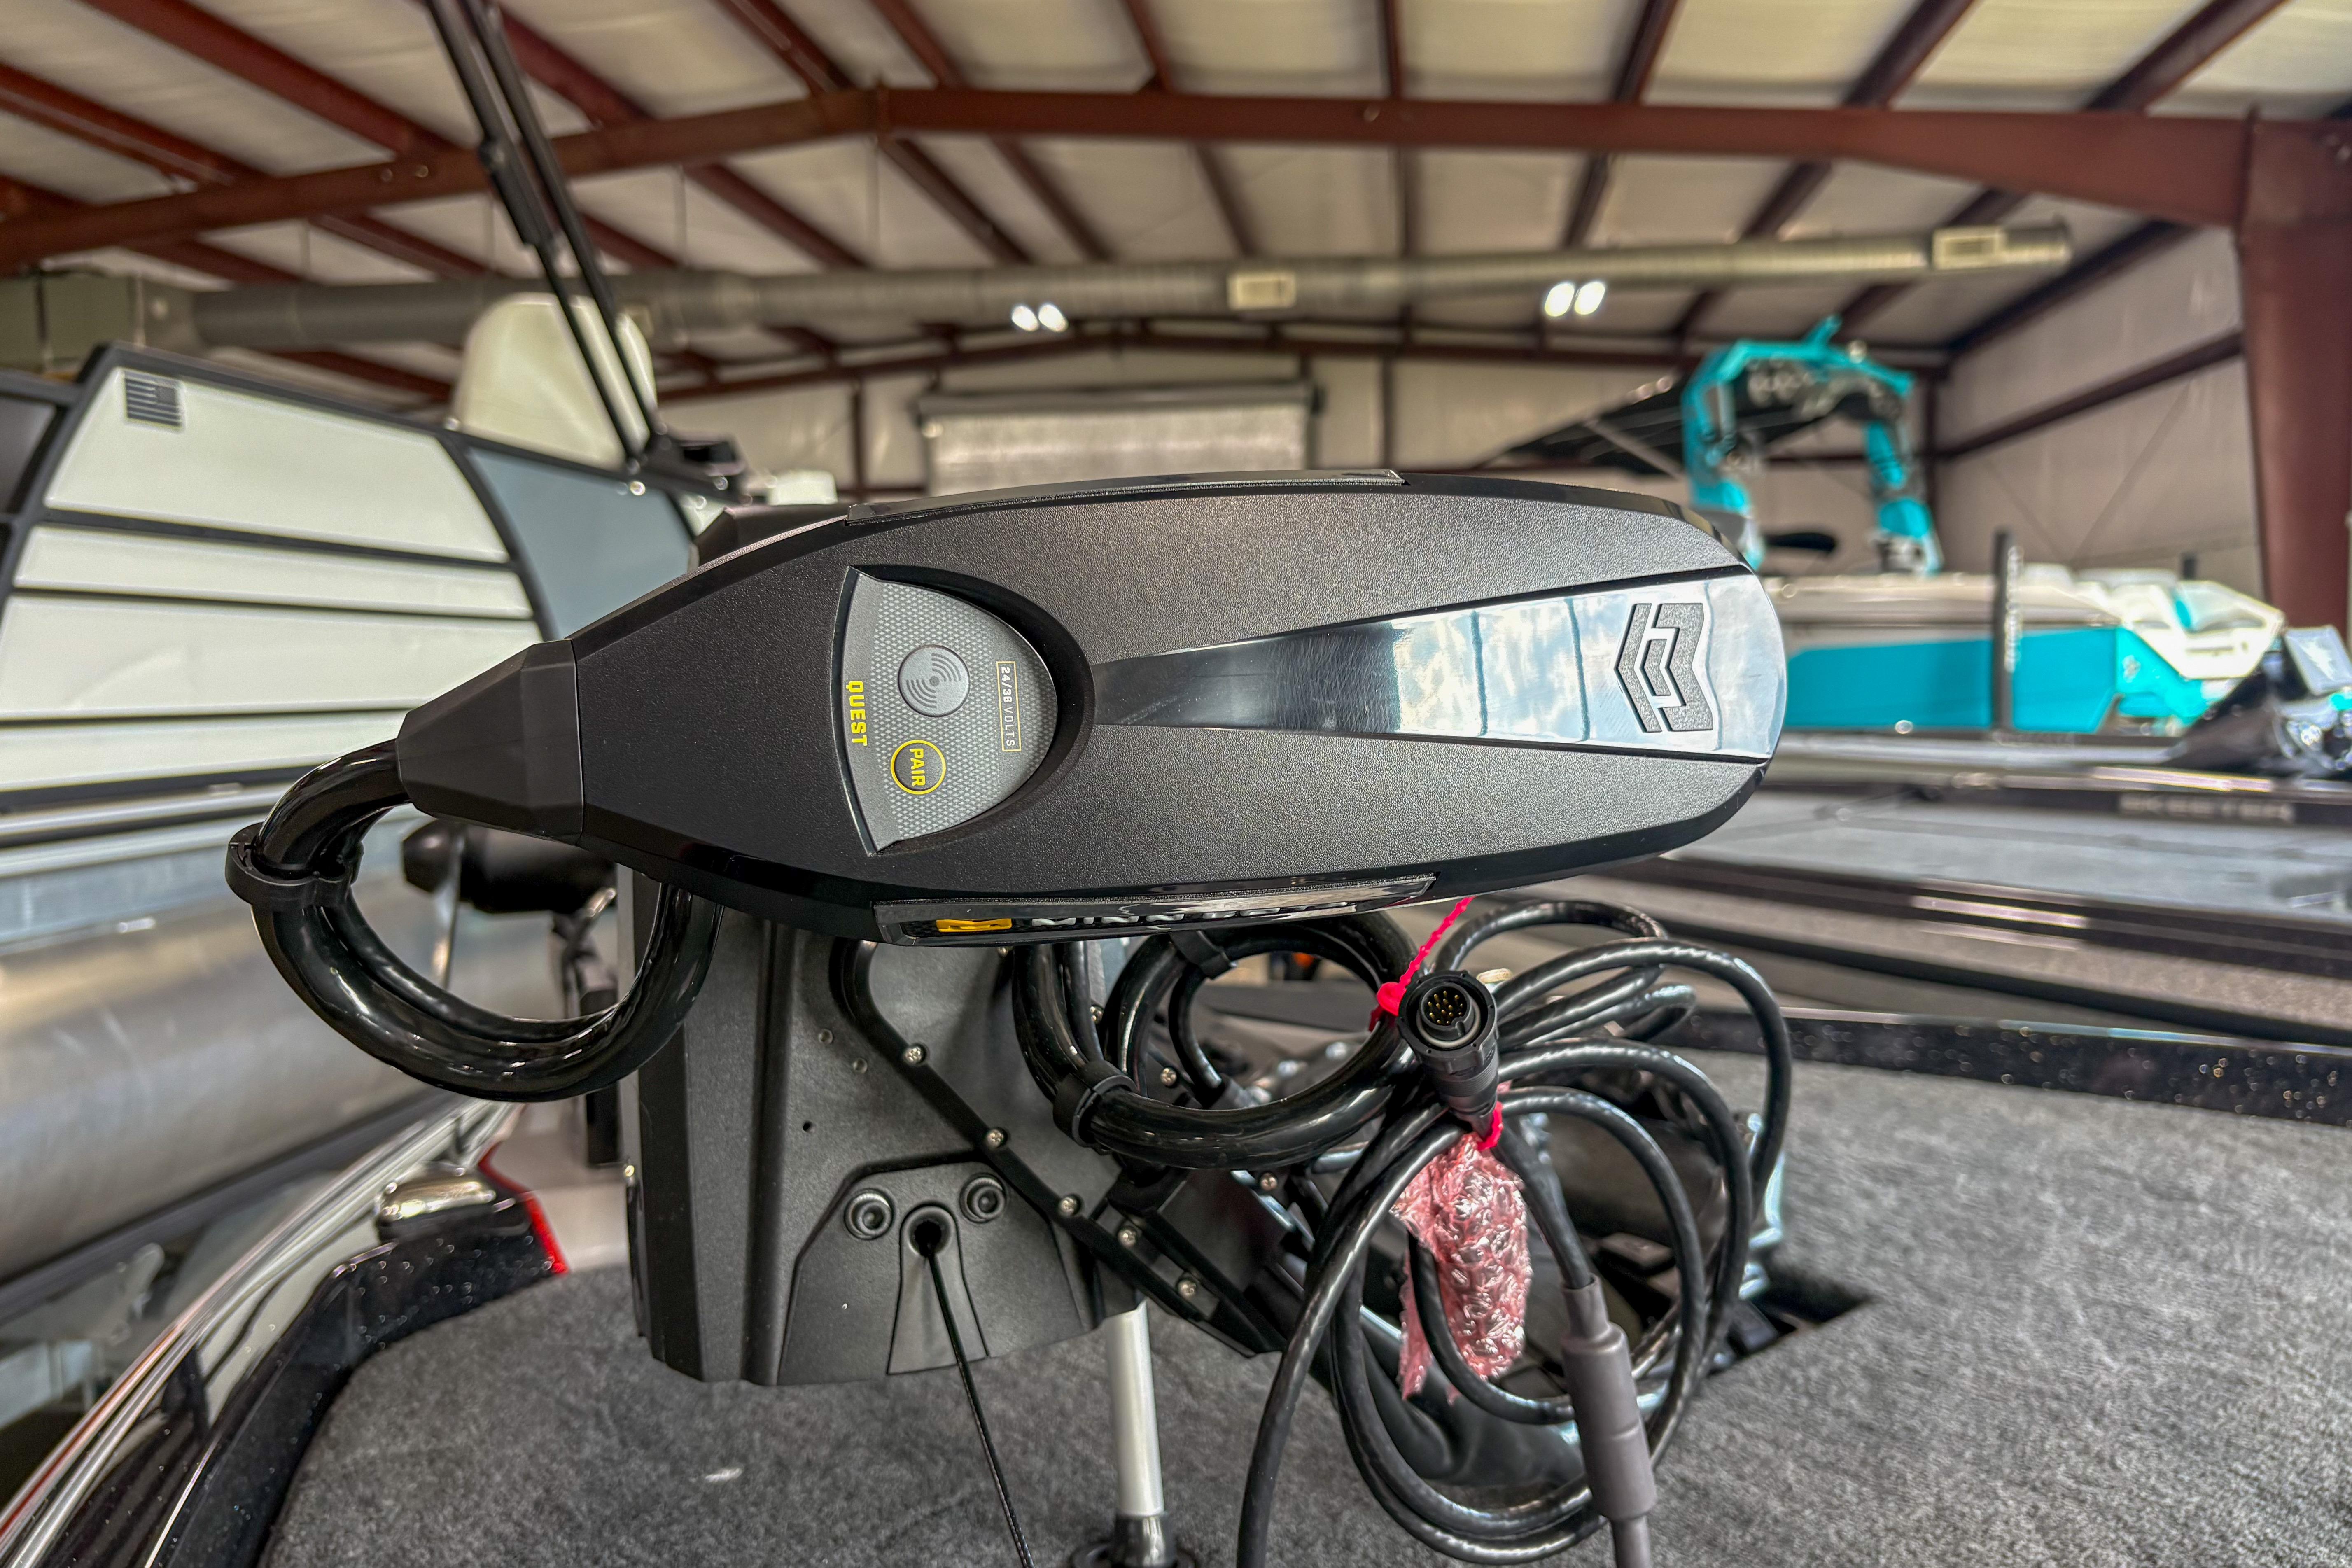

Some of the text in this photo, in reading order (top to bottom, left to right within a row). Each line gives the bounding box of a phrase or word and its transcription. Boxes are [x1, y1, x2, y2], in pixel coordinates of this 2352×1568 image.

[847, 681, 868, 745] QUEST
[1001, 667, 1016, 747] 24/36 VOLTS
[910, 748, 926, 786] PAIR
